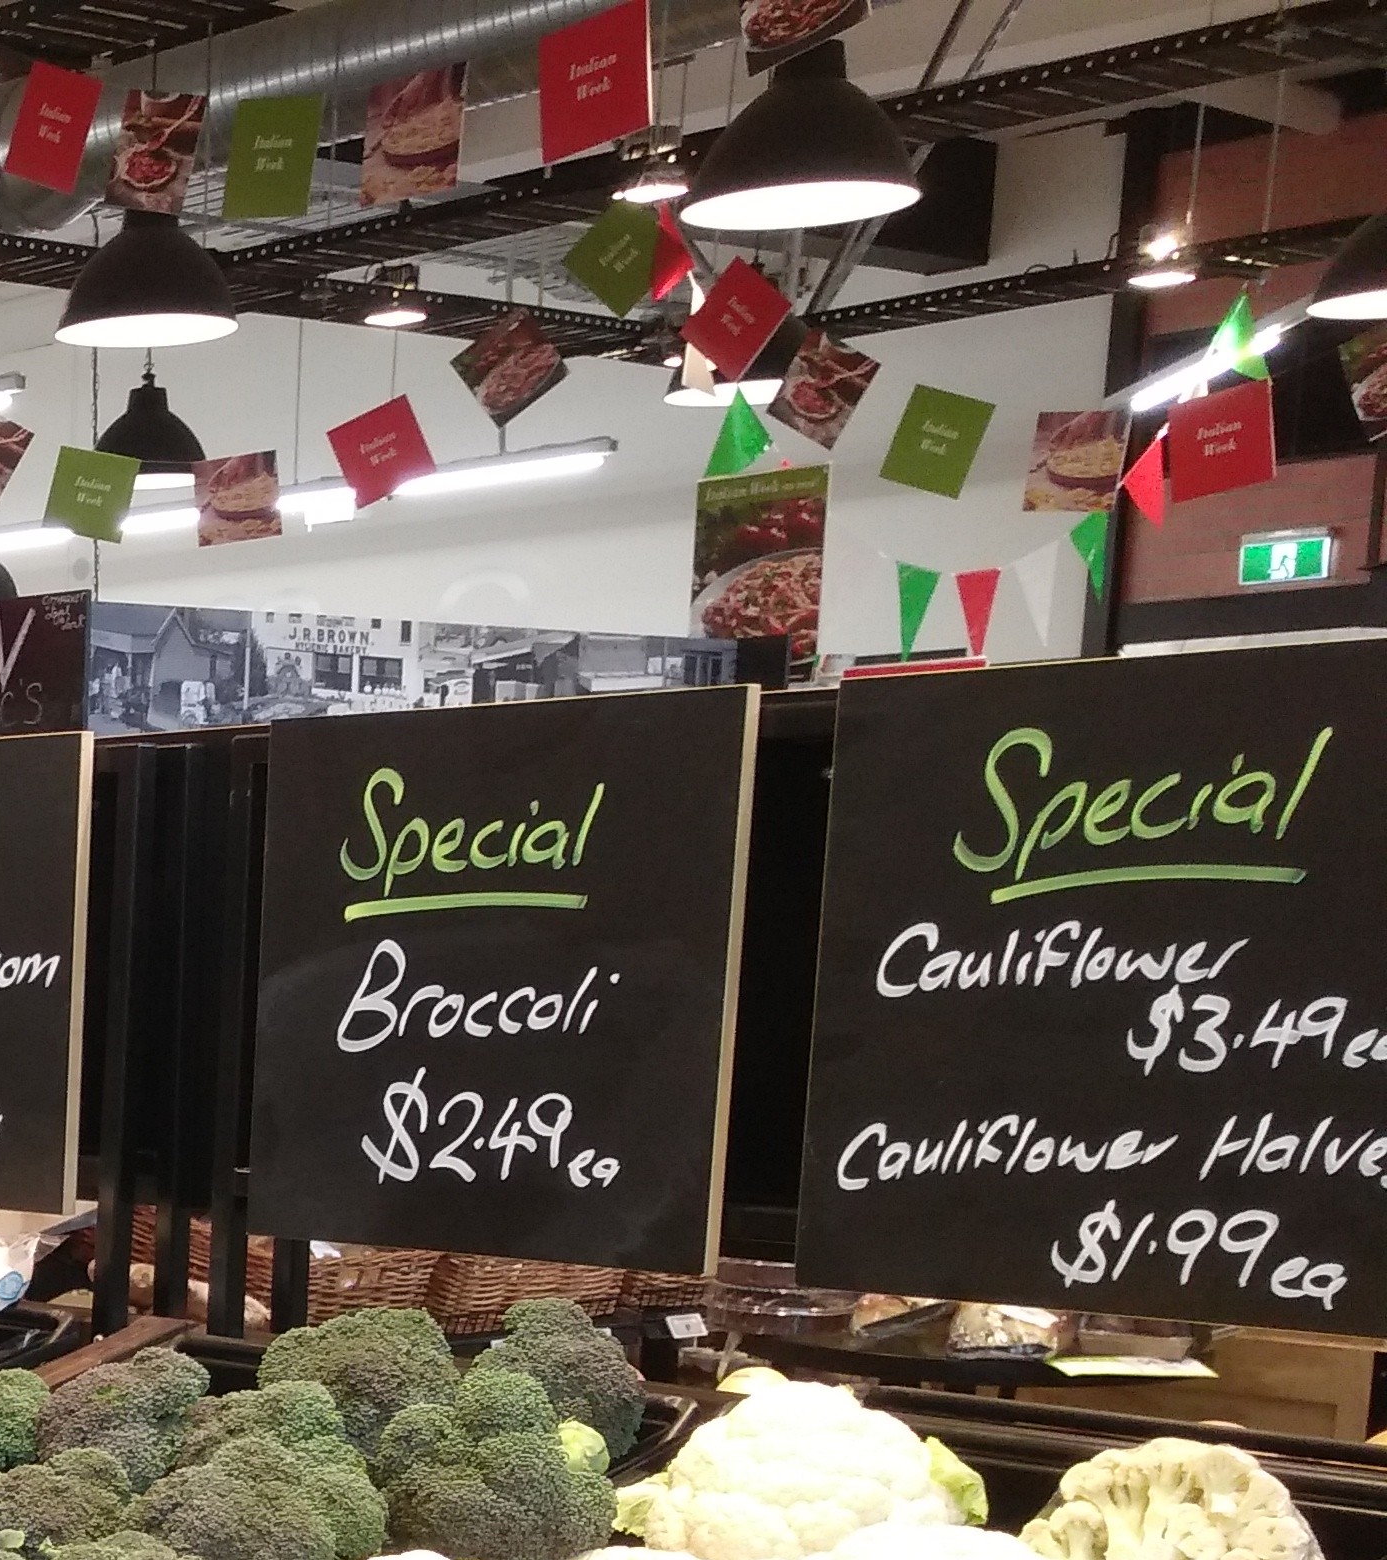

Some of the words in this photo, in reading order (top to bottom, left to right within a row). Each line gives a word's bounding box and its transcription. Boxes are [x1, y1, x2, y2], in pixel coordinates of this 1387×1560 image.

[339, 765, 605, 899] Special
[953, 726, 1334, 881] Special
[337, 937, 622, 1054] Broccoli
[875, 920, 1251, 998] Cauliflower
[836, 1114, 1181, 1192] Cauliflower
[1199, 1111, 1387, 1188] Halve
